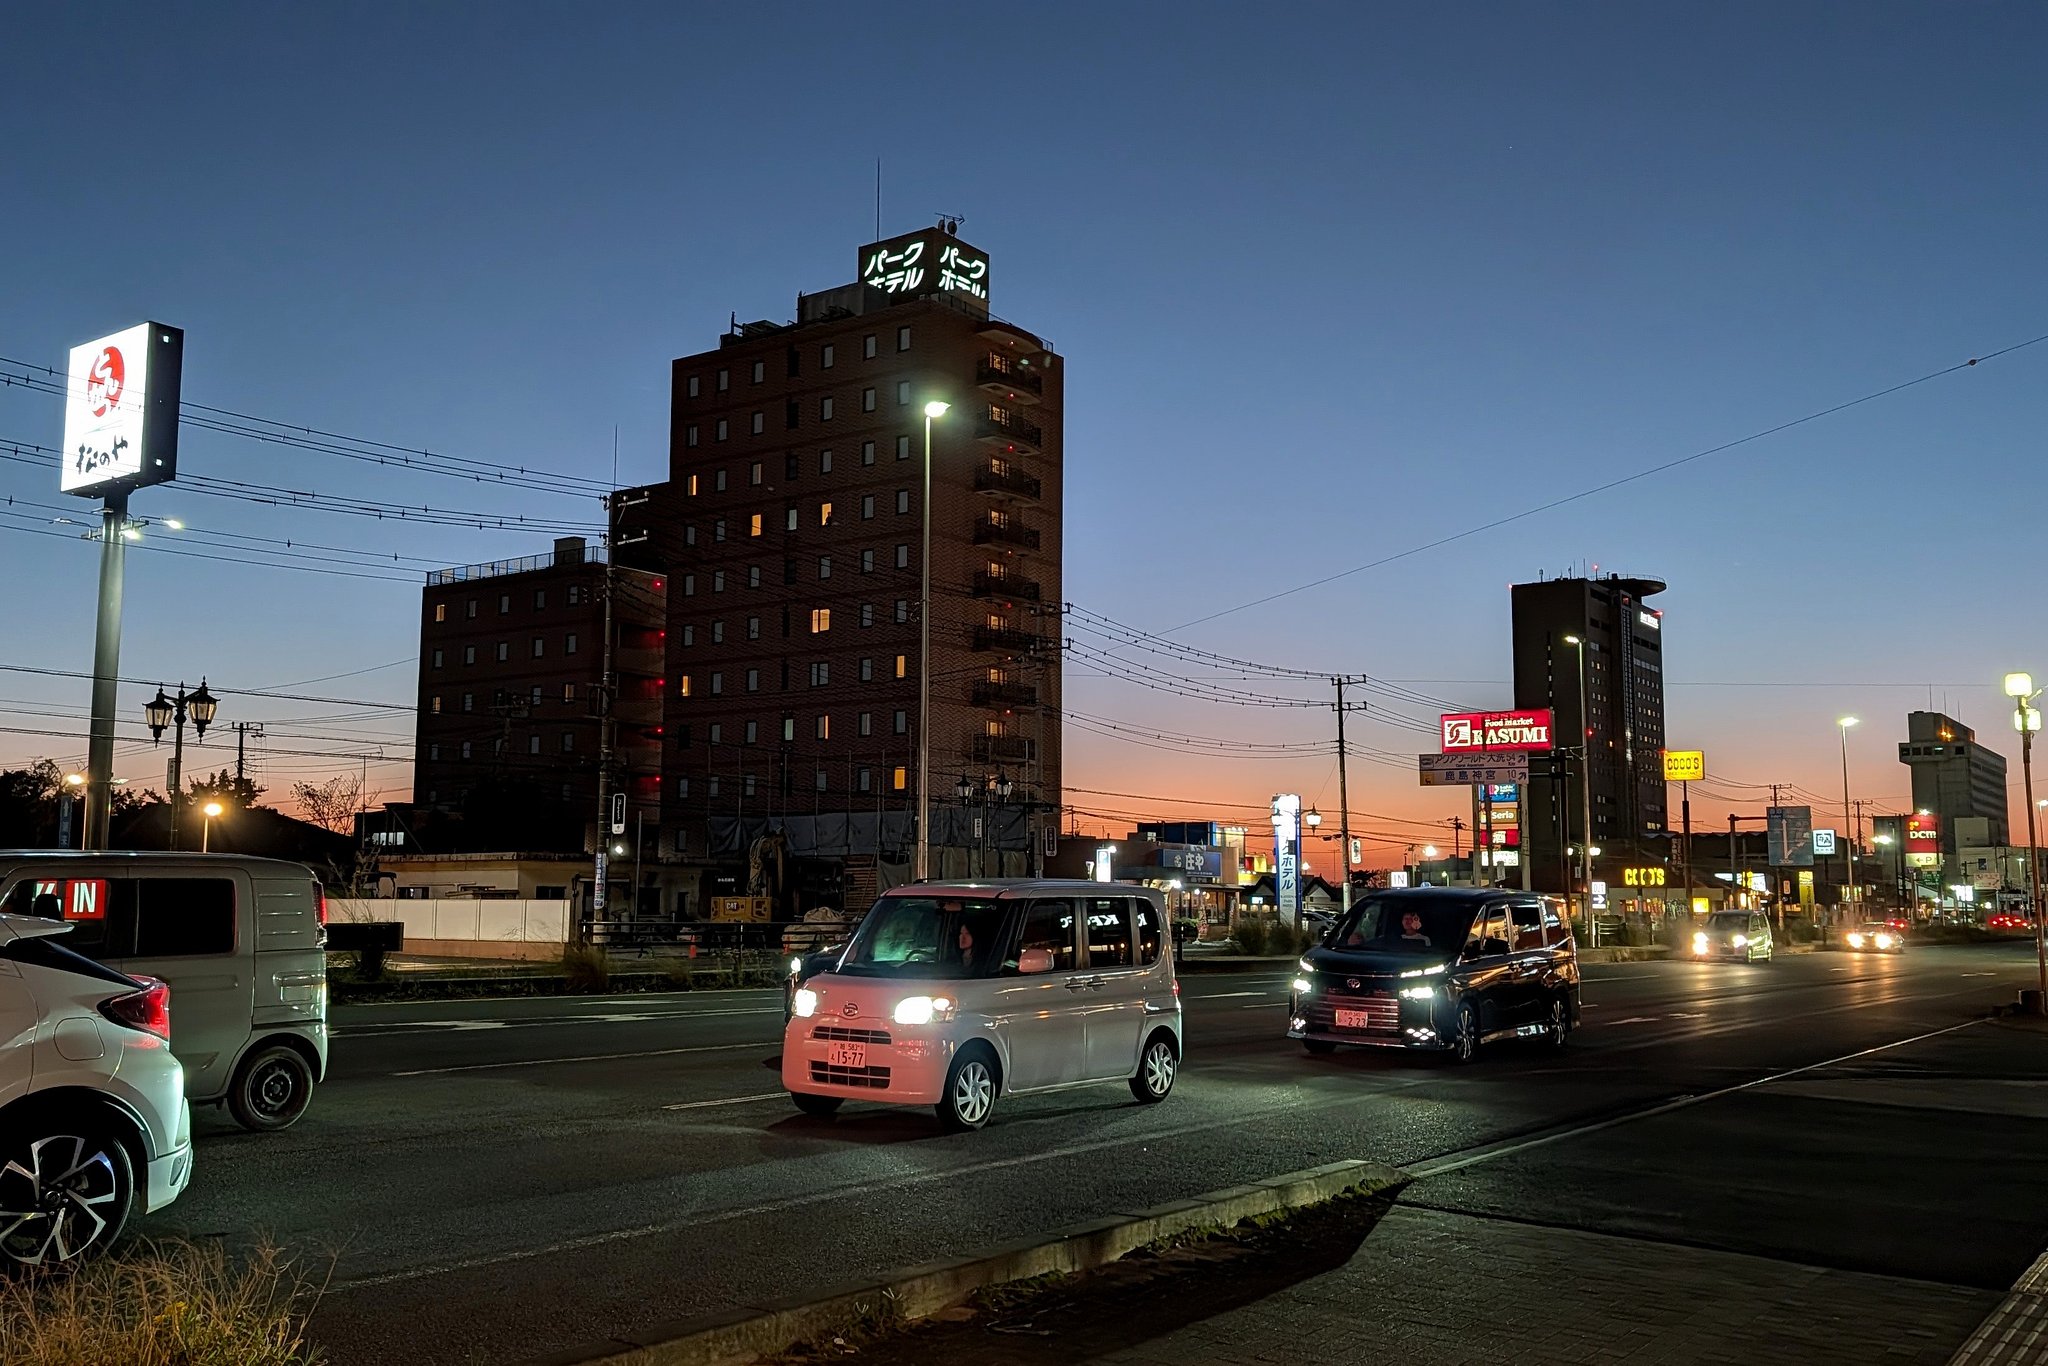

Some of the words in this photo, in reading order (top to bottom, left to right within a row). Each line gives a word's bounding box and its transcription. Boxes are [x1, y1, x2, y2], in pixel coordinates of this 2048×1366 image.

[864, 242, 925, 277] パーク
[939, 245, 986, 279] パーク
[1471, 727, 1548, 745] KASUMI
[1506, 753, 1516, 762] 54
[1667, 756, 1700, 770] COCO'S
[1445, 770, 1495, 780] 鹿島神宮
[1507, 769, 1517, 779] 10
[1491, 811, 1514, 820] Seria
[72, 882, 97, 913] IN
